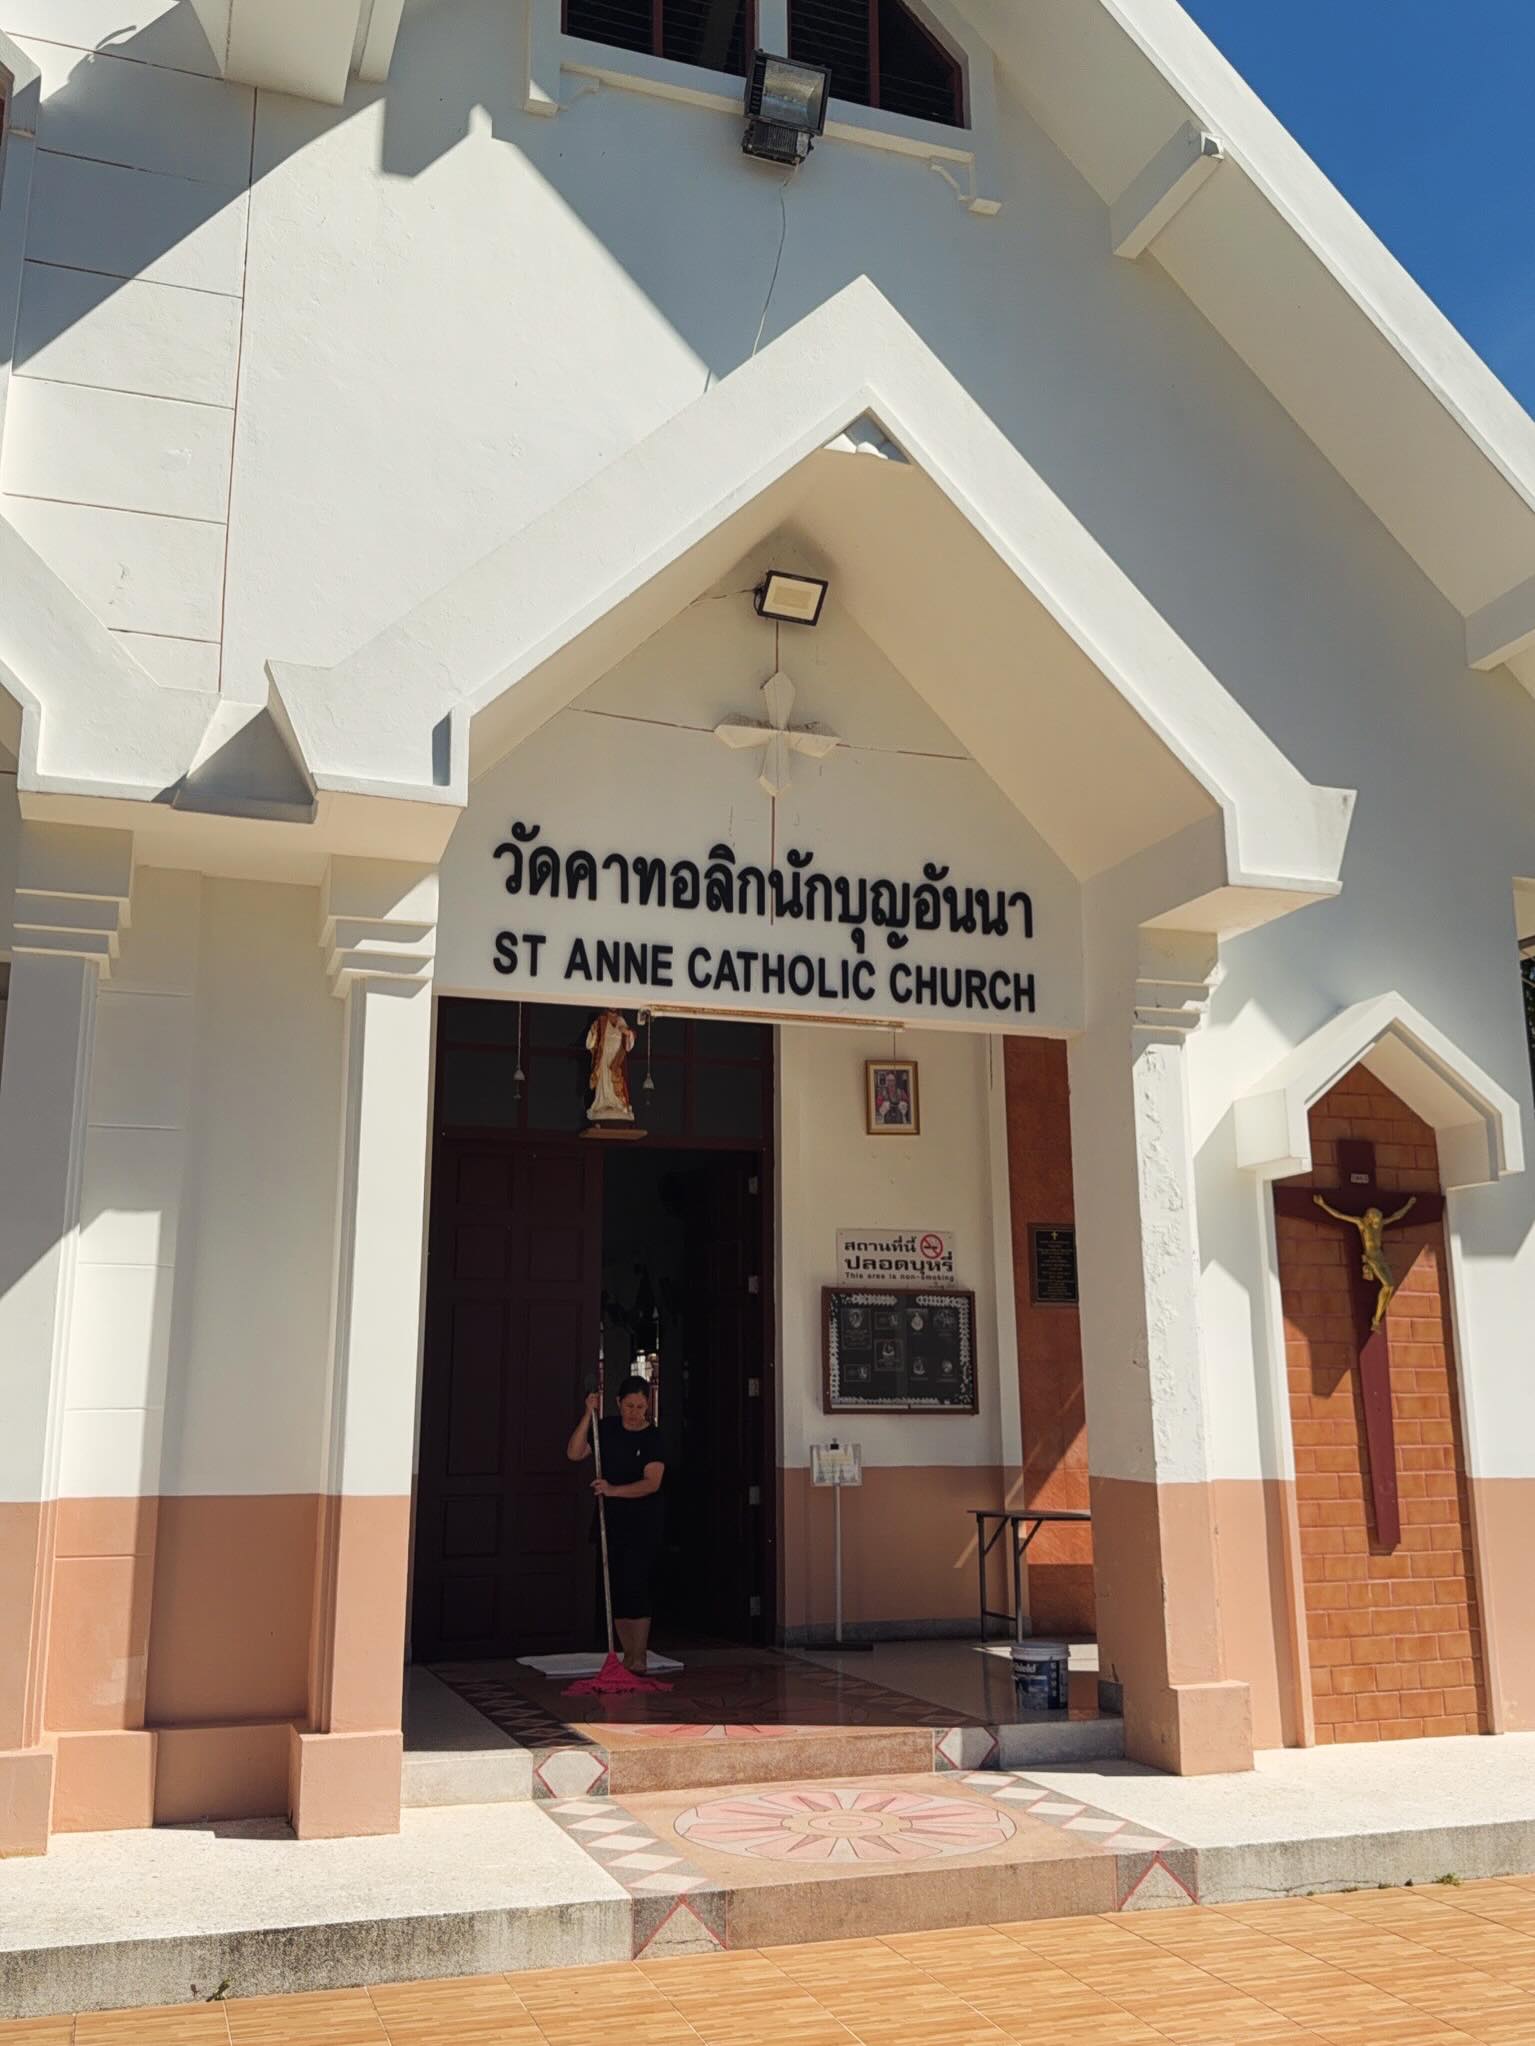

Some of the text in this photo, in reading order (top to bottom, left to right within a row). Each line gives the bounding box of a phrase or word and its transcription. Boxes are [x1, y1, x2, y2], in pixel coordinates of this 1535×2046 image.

[493, 821, 1033, 954] วัดคาทอลิกนักบุญอันนา
[493, 931, 1036, 1013] ST ANNE CATHOLIC CHURCH
[844, 1235, 917, 1252] สถานที่นี้
[844, 1251, 953, 1274] ปลอดบุหรี่
